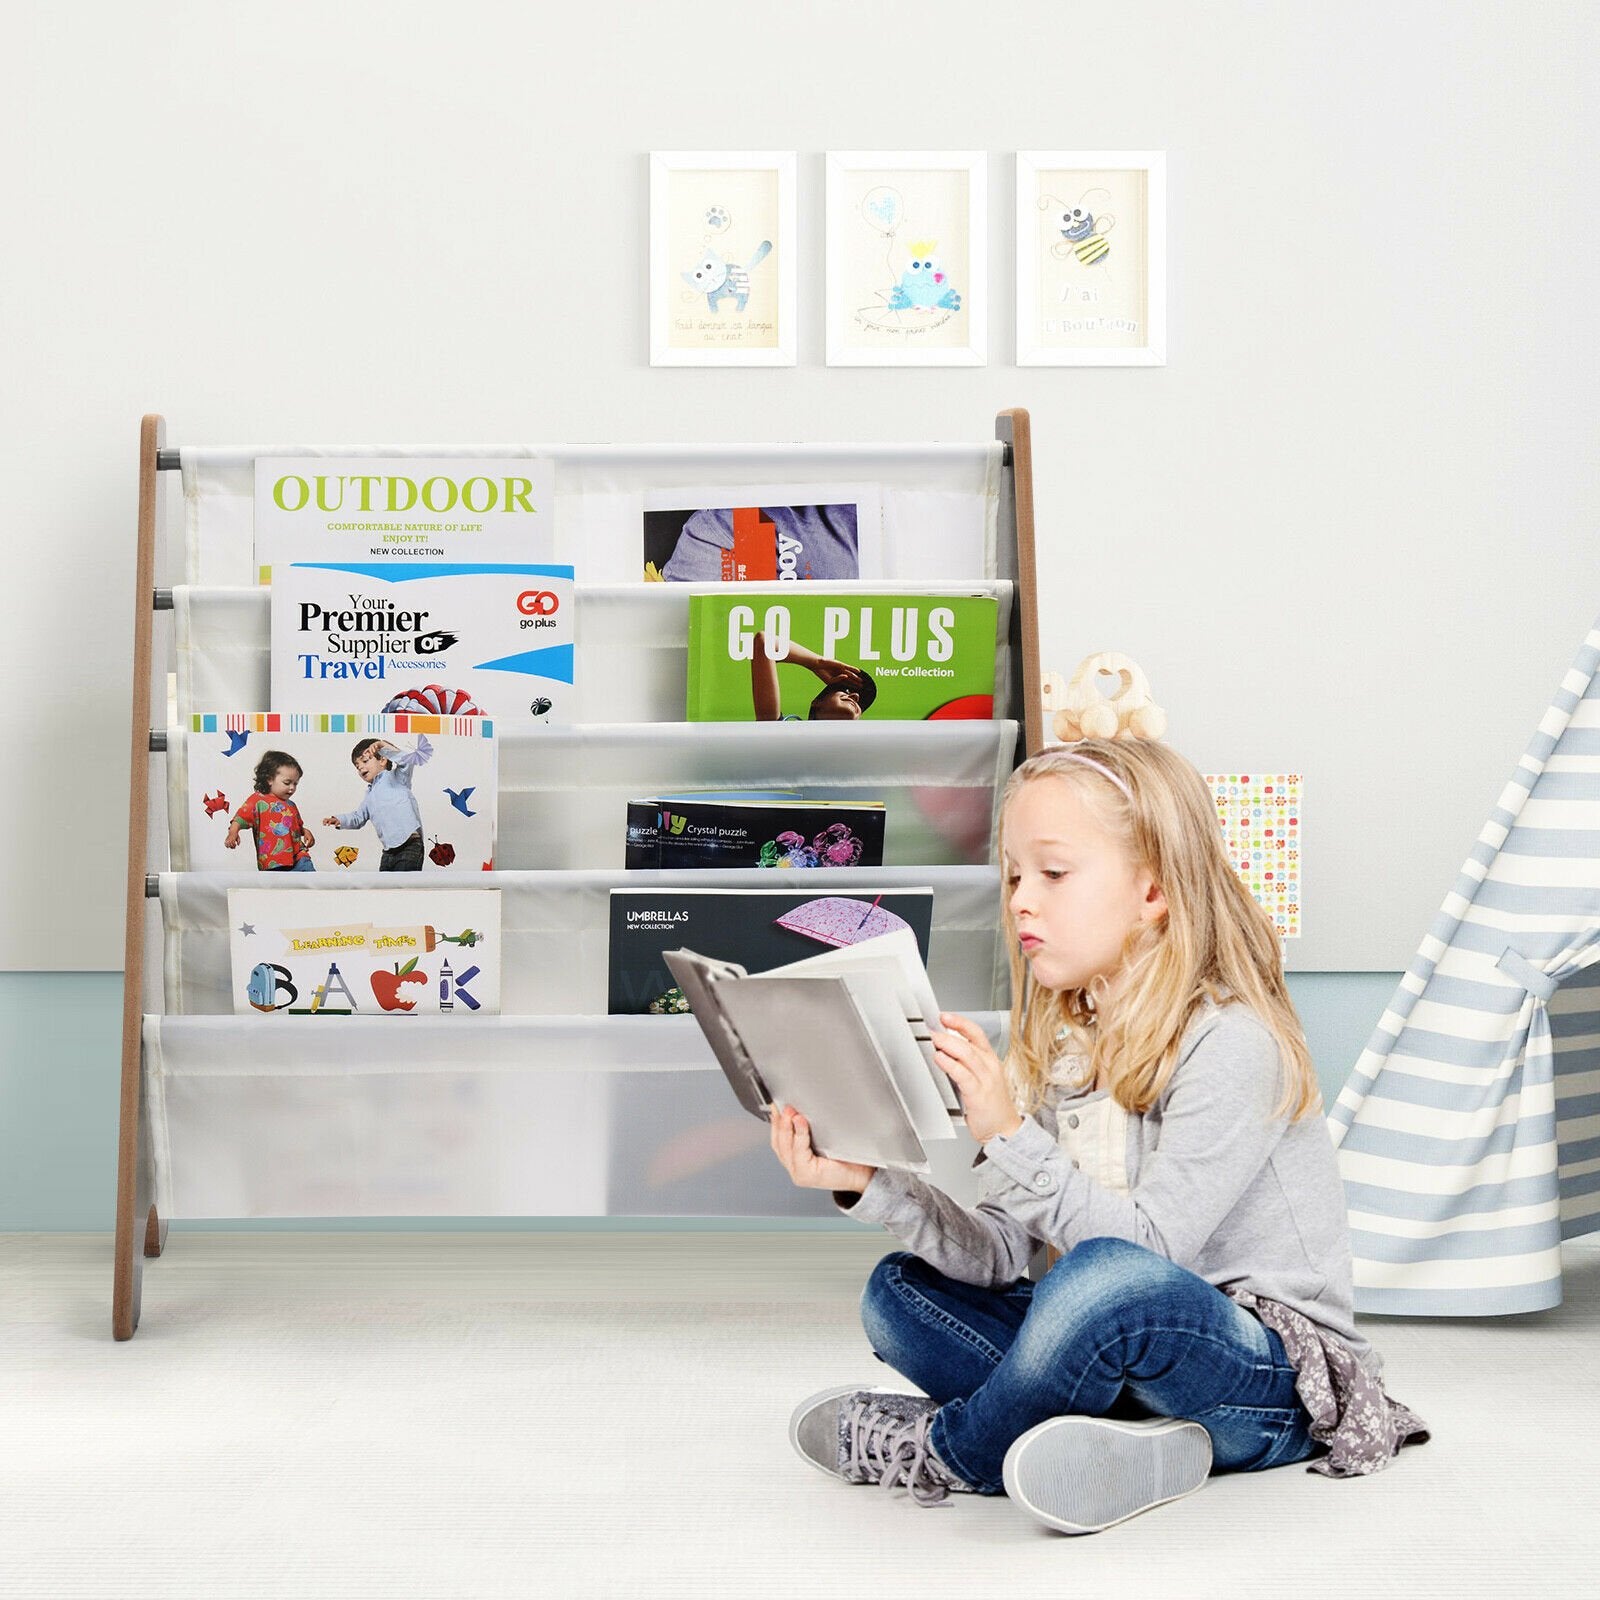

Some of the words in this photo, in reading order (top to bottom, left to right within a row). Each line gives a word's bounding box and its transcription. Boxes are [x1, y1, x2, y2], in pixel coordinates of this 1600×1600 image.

[273, 475, 537, 513] OUTDOOR
[327, 522, 403, 532] COMFORTABLE
[404, 523, 443, 532] NATURE
[444, 523, 459, 532] OF
[460, 523, 483, 532] LIFE
[383, 534, 413, 544] ENJOY
[415, 534, 429, 543] IT!
[370, 547, 390, 556] NEW
[391, 547, 444, 556] COLLECTION
[348, 594, 388, 610] Your
[516, 590, 559, 616] GO
[297, 603, 429, 632] Premier
[520, 619, 534, 630] go
[535, 617, 557, 630] plus
[728, 605, 791, 661] GO
[823, 606, 955, 662] PLUS
[327, 633, 411, 658] Supplier
[422, 637, 444, 650] OF
[297, 655, 386, 680] Travel
[387, 658, 447, 670] Accessories
[875, 667, 900, 677] New
[901, 666, 955, 678] Collection
[629, 826, 658, 837] puzzle
[687, 824, 717, 835] Crystal
[718, 826, 748, 837] puzzle
[626, 911, 689, 922] UMBRELLAS
